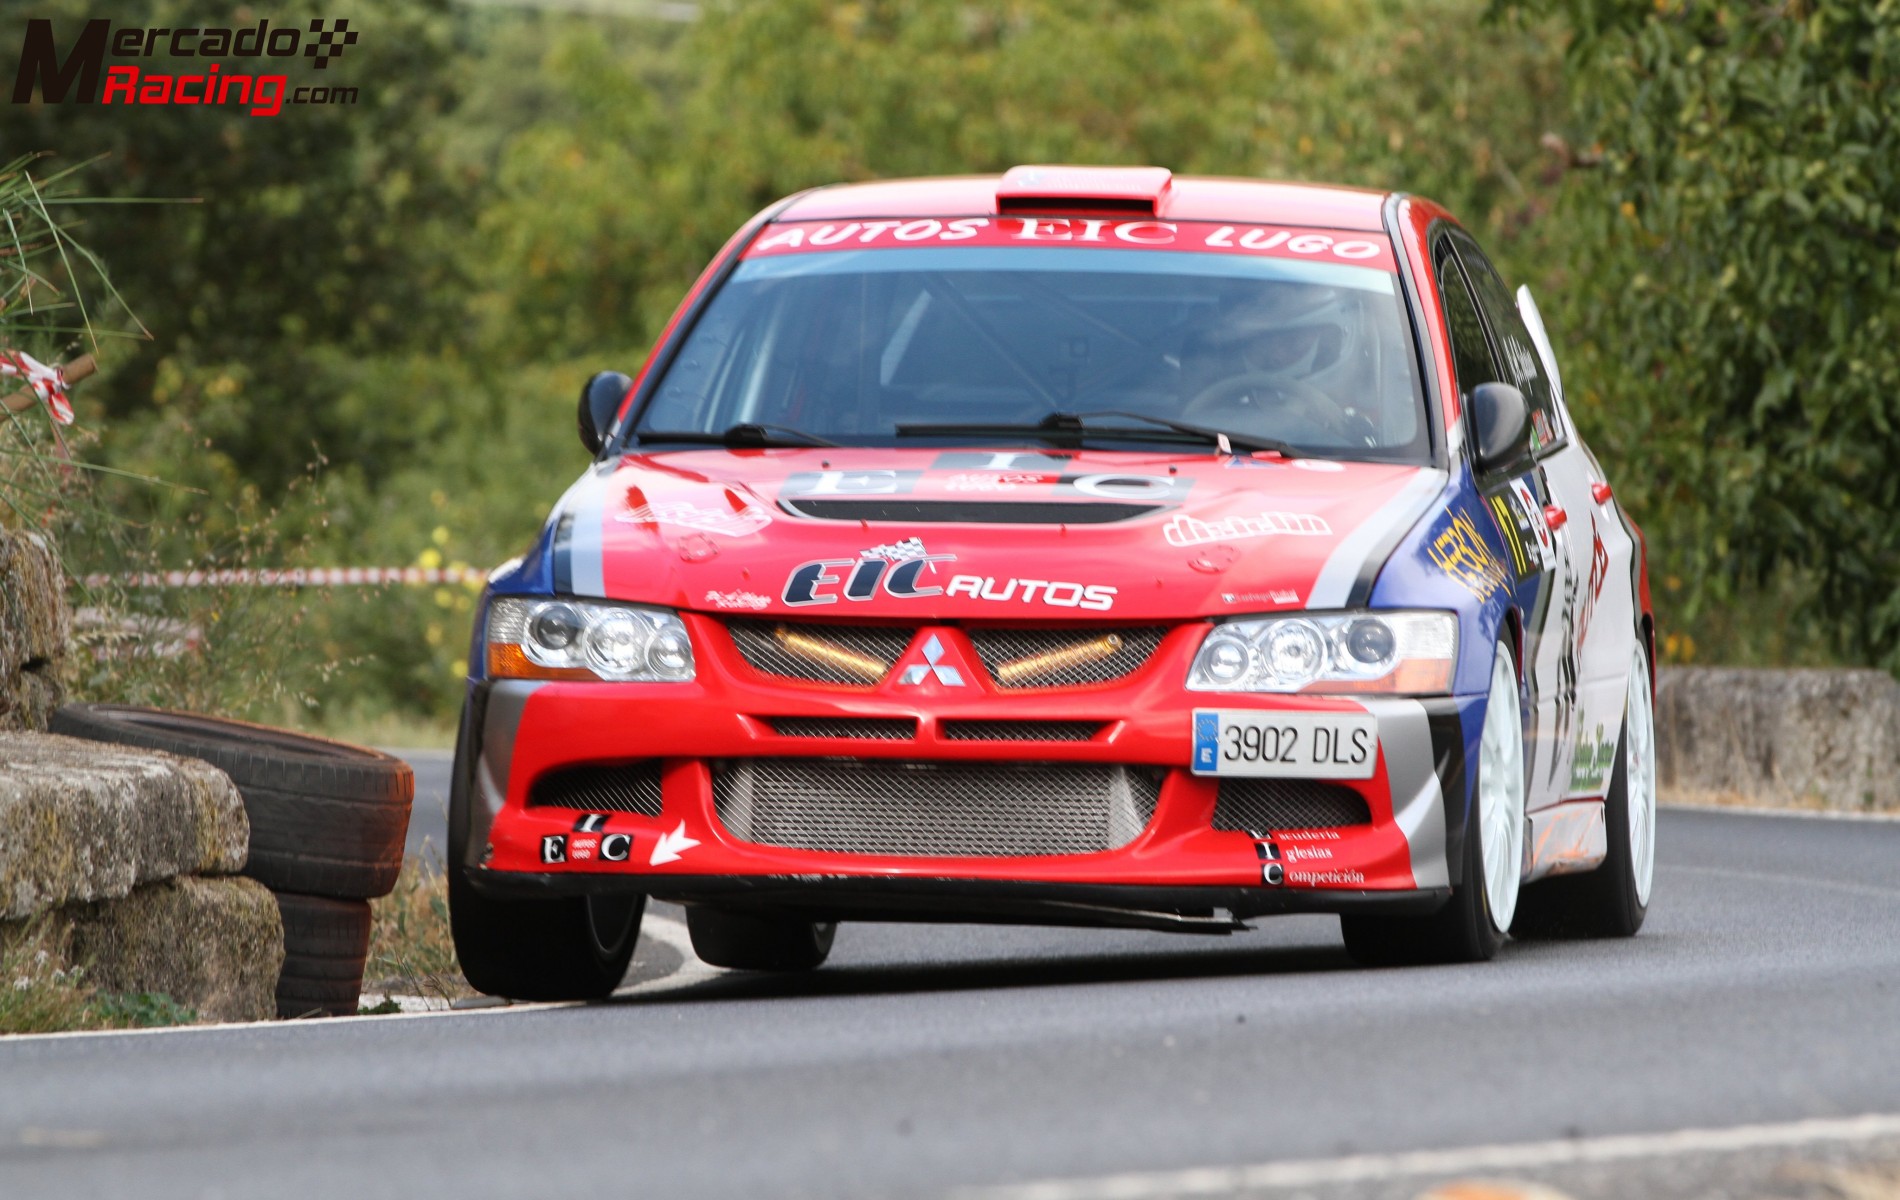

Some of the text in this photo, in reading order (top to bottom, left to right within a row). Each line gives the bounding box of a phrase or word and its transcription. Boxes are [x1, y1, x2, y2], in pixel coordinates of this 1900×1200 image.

[758, 217, 1381, 259] AUTOS EIC LUGO
[781, 554, 957, 607] EIC
[945, 575, 1118, 610] AUTOS
[1224, 725, 1368, 764] 3902 DLS
